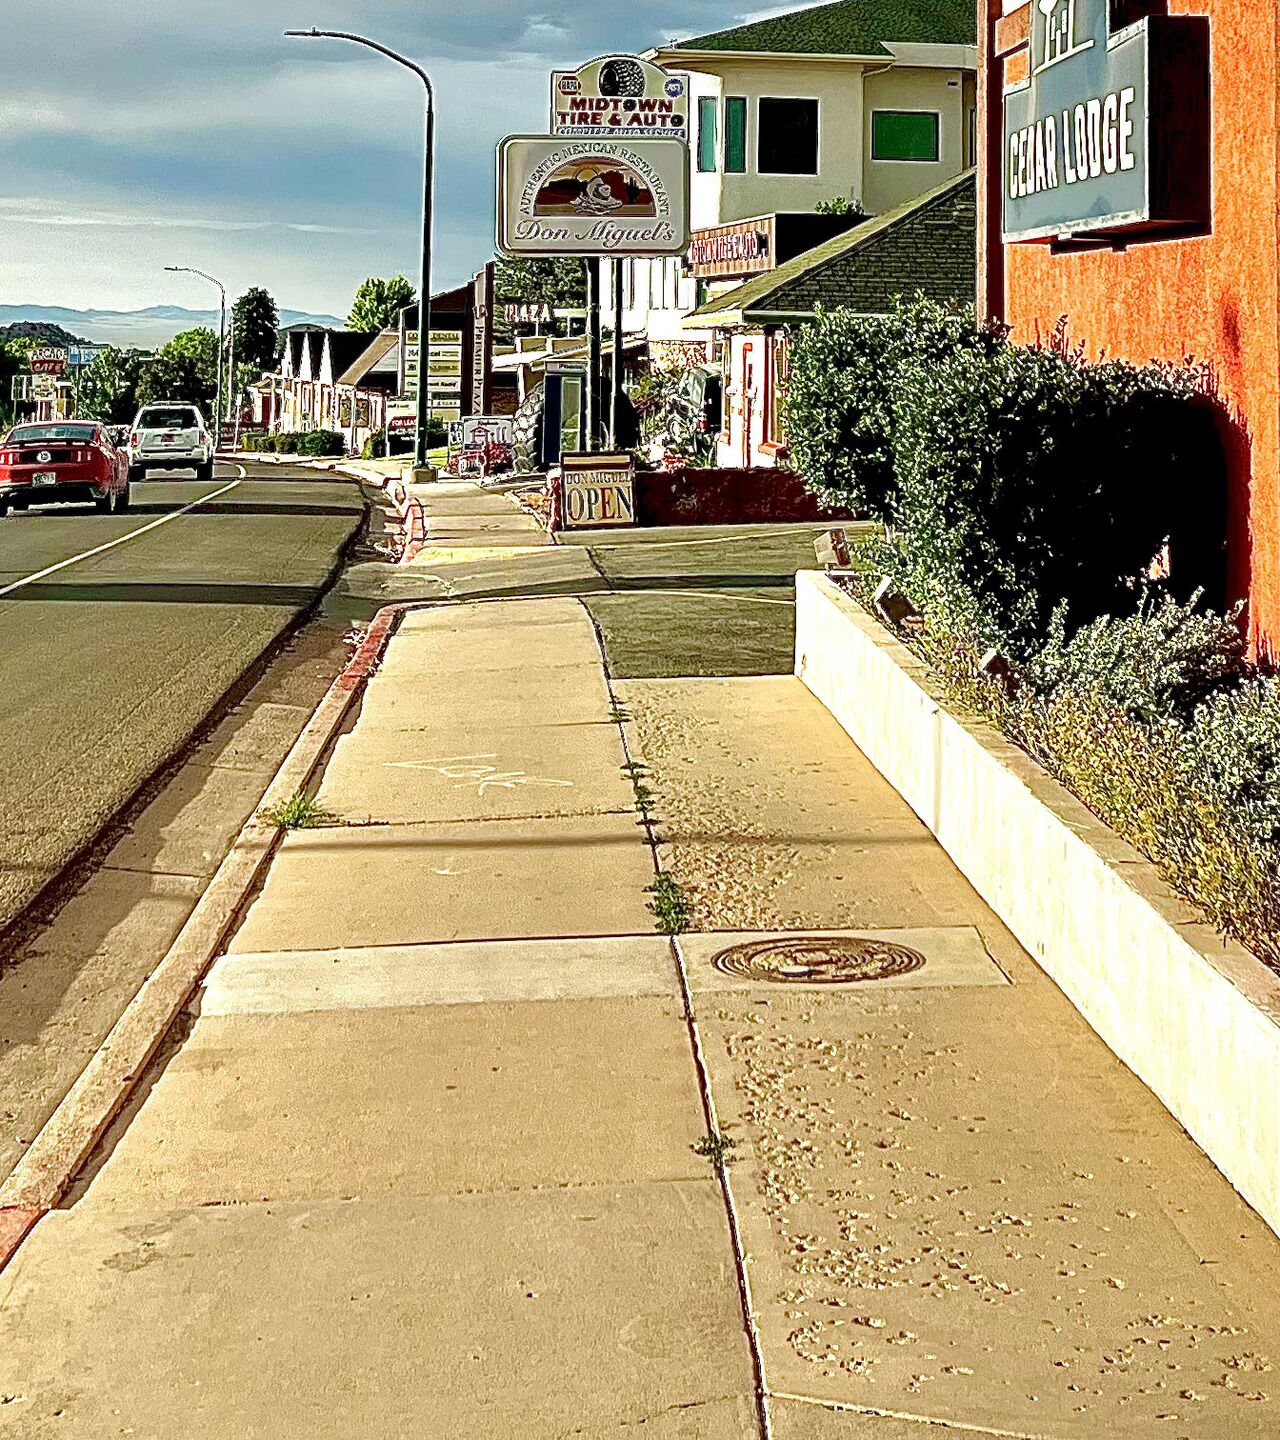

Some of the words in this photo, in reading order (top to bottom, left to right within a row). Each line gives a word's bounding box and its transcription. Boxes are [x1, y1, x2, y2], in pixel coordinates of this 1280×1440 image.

[570, 98, 674, 113] MIDTOWN
[557, 112, 603, 127] TIRE
[607, 112, 622, 127] &
[626, 113, 685, 127] AUTO
[1009, 115, 1058, 200] CEDAR
[1062, 86, 1135, 184] LODGE
[519, 152, 563, 215] AUTHENTIC
[561, 143, 618, 160] MEXICAN
[619, 149, 670, 216] RESTAURANT
[515, 219, 570, 241] Don
[574, 219, 675, 248] Miguel's
[504, 303, 552, 323] PLAZA
[566, 472, 588, 485] DON
[567, 486, 632, 521] OPEN
